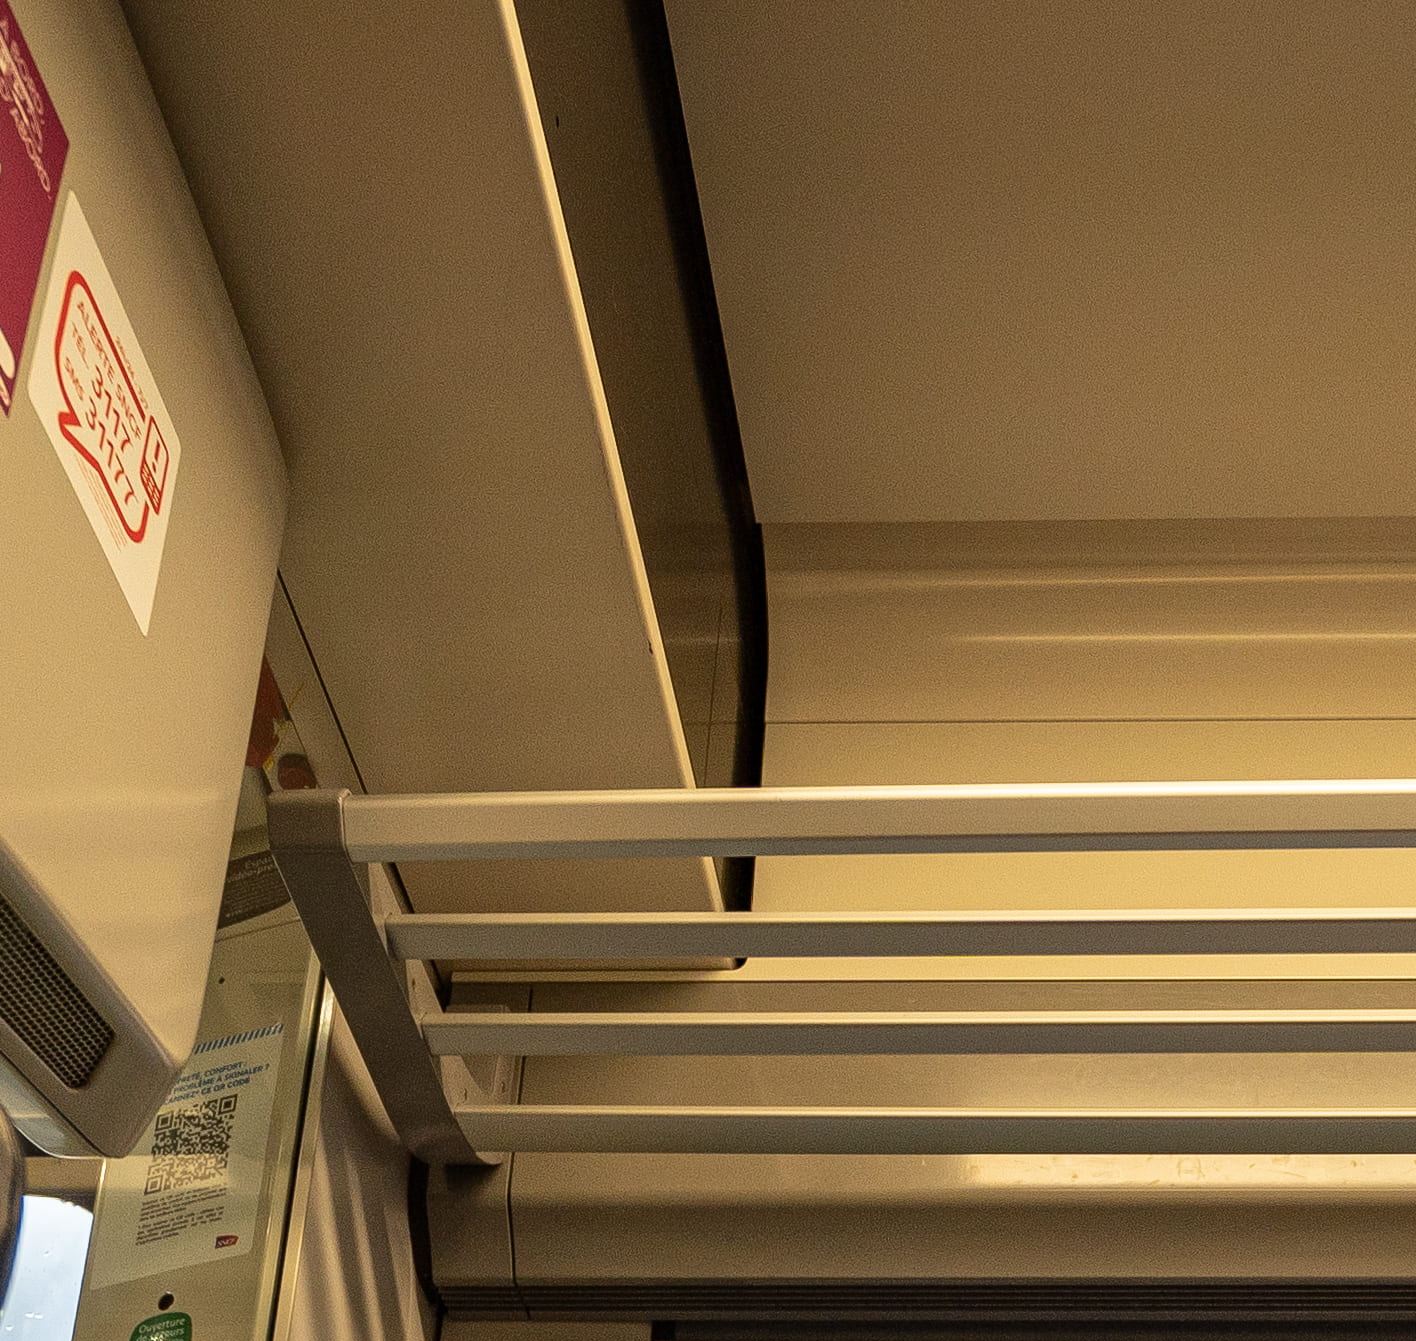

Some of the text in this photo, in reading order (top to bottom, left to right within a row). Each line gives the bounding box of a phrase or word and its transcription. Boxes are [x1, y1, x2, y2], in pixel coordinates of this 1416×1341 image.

[77, 302, 141, 440] ALERTE SNCF
[64, 356, 85, 401] SMS
[84, 395, 138, 506] 31177
[90, 363, 133, 453] 3117
[225, 1065, 263, 1080] SIGNALER
[227, 1077, 250, 1089] CODE
[139, 1318, 185, 1334] Ouverture
